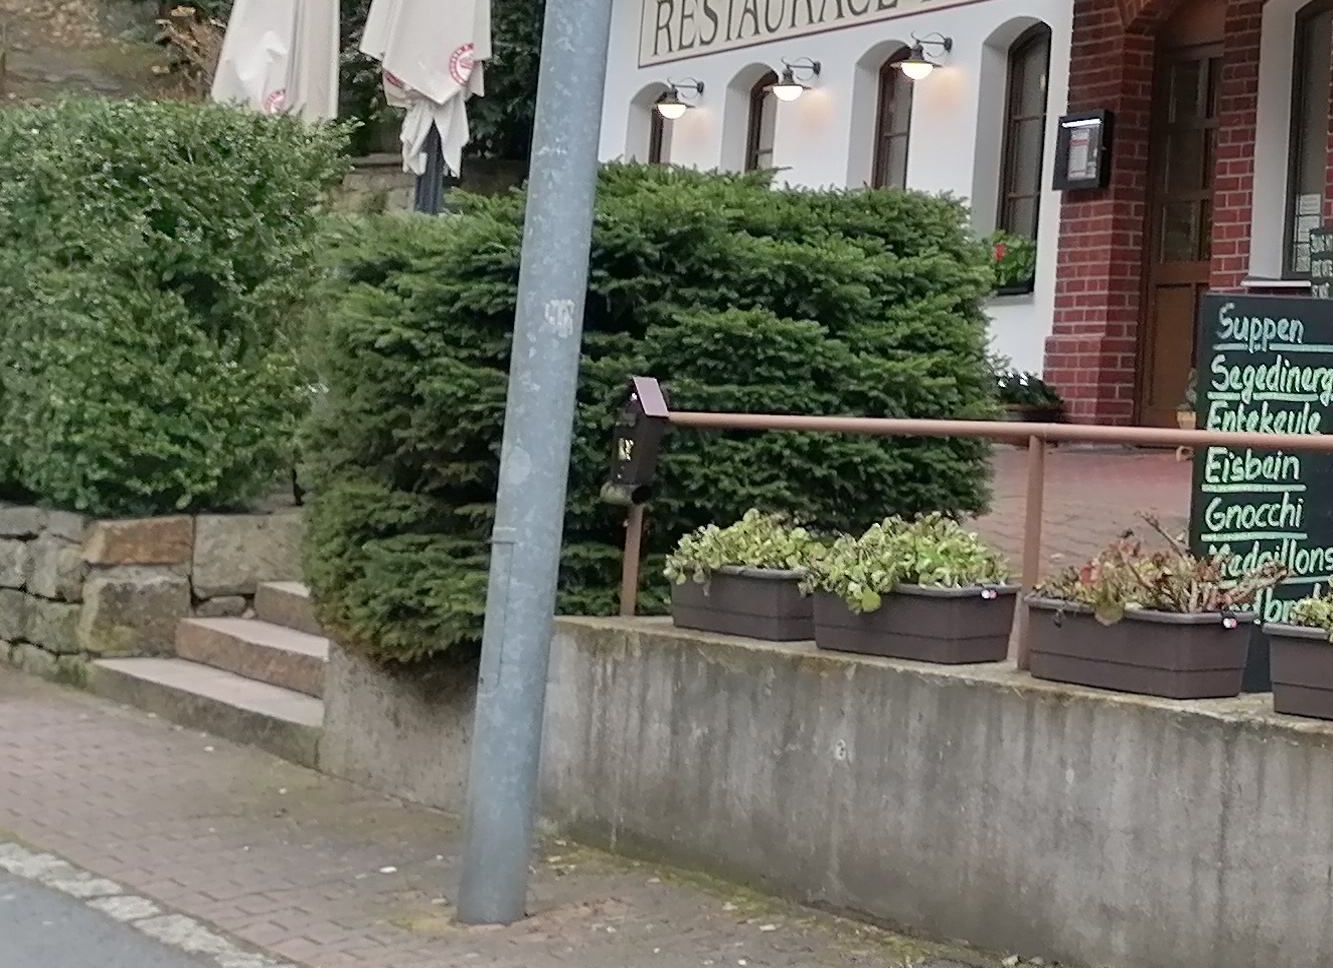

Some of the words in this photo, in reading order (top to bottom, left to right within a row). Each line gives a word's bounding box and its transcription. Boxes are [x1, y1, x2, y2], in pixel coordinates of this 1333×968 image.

[1215, 301, 1305, 354] Suppen
[1204, 445, 1301, 484] Eisbein
[1204, 491, 1305, 533] Gnocchi
